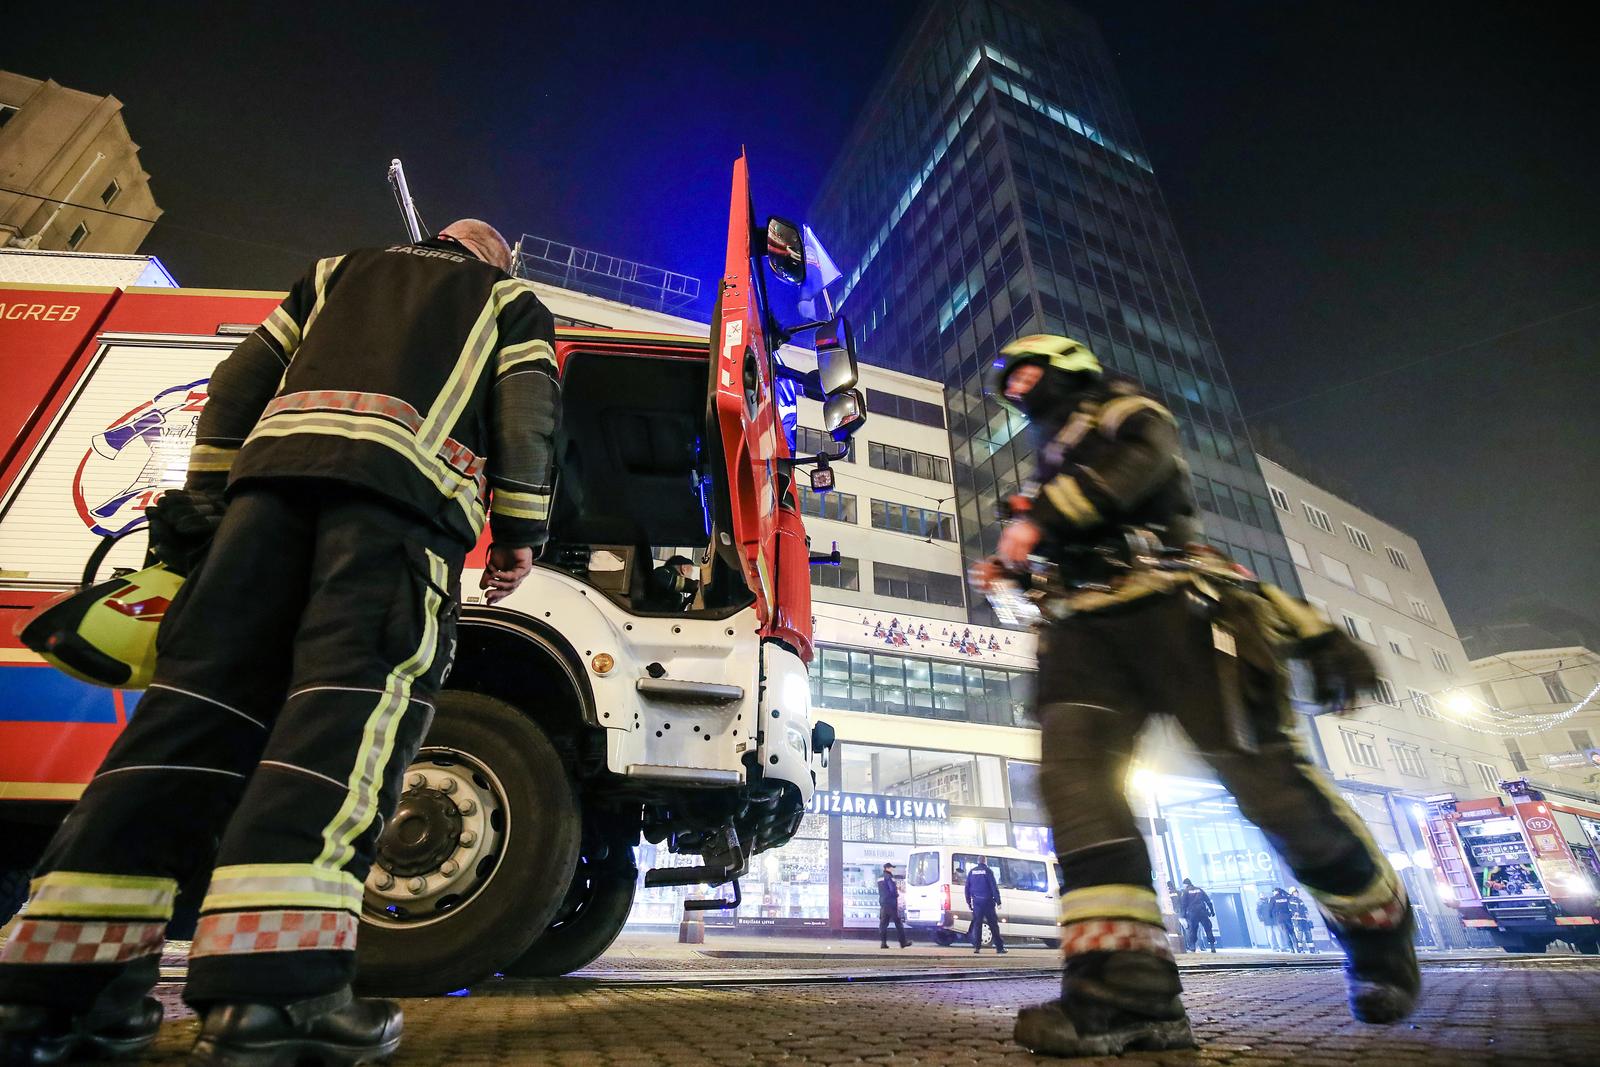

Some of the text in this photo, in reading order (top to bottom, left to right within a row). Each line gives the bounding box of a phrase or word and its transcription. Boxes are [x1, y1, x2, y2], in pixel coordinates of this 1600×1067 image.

[384, 246, 466, 263] ZAGREB
[885, 799, 946, 818] LJEVAK
[1530, 820, 1547, 829] 193
